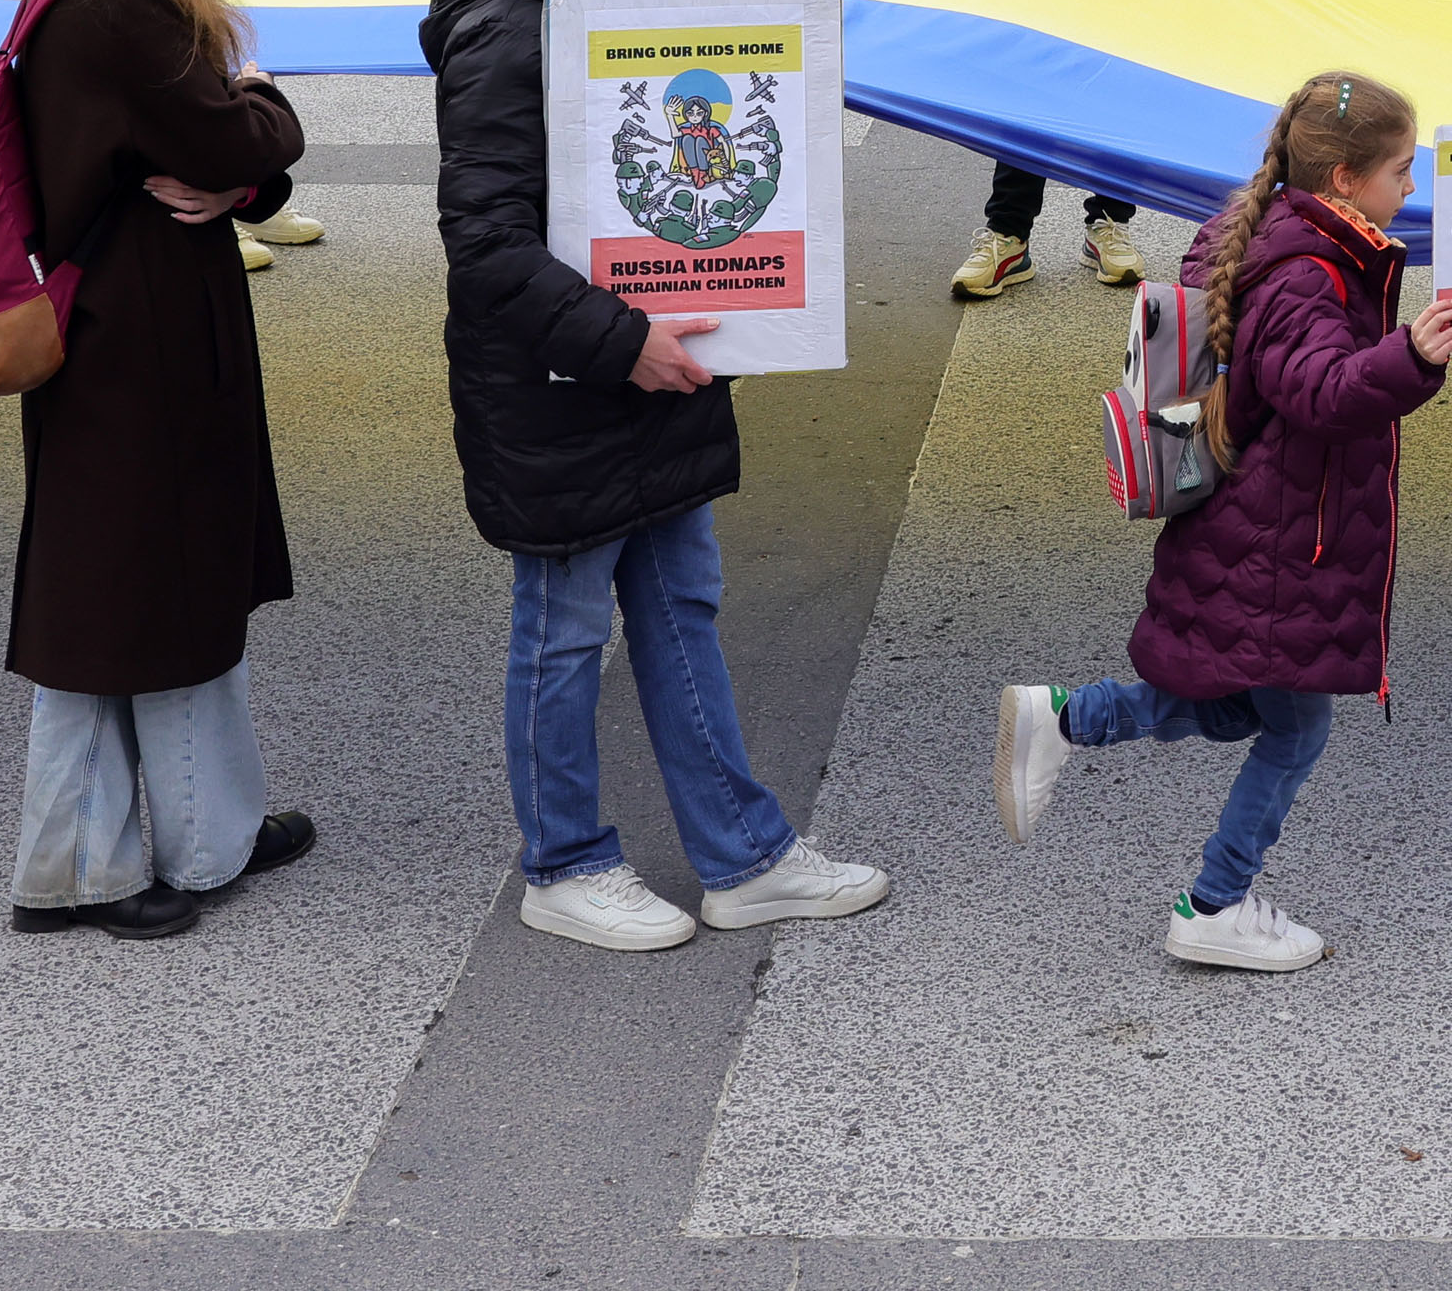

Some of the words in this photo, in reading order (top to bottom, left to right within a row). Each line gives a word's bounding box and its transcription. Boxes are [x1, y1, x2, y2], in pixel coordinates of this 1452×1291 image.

[606, 46, 656, 60] BRING
[659, 45, 693, 58] OUR
[697, 44, 735, 57] KIDS
[738, 42, 785, 56] HOME
[610, 258, 688, 277] RUSSIA
[692, 255, 786, 274] KIDNAPS
[610, 279, 702, 295] UKRAINIAN
[706, 276, 786, 291] CHILDREN
